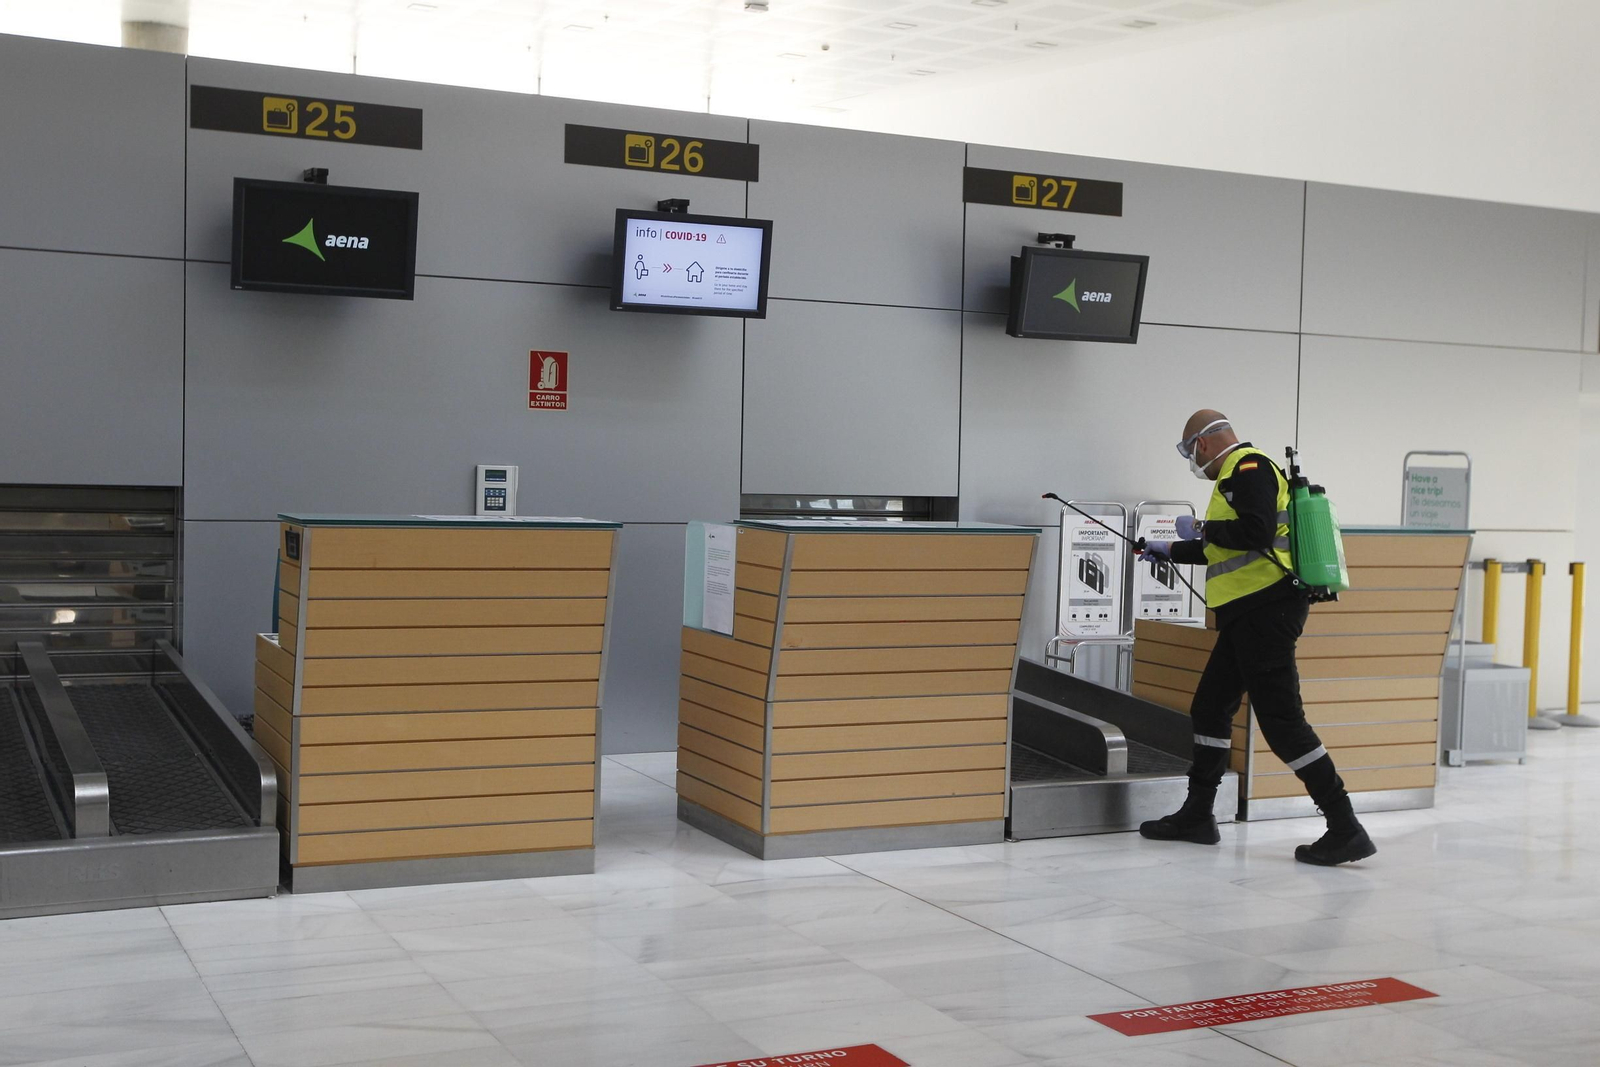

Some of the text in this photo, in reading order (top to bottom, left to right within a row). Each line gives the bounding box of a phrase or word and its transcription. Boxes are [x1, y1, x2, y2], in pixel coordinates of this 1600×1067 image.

[305, 102, 357, 140] 25
[660, 137, 704, 174] 26
[1041, 178, 1078, 209] 27
[324, 233, 369, 250] aena
[636, 226, 707, 242] info COVID-19
[1081, 290, 1112, 303] aena
[1412, 474, 1432, 484] Have
[1411, 486, 1426, 495] nice
[1120, 1010, 1161, 1020] POR
[1225, 992, 1293, 1005] ESPERE
[1292, 988, 1318, 996] SU
[1318, 982, 1378, 993] TURNO
[1158, 990, 1372, 1022] PLEASE WAIT FOR YOUR TURN
[1192, 1014, 1242, 1026] BITTE
[1242, 1006, 1310, 1019] ABSTAND
[771, 1050, 847, 1065] TURNO
